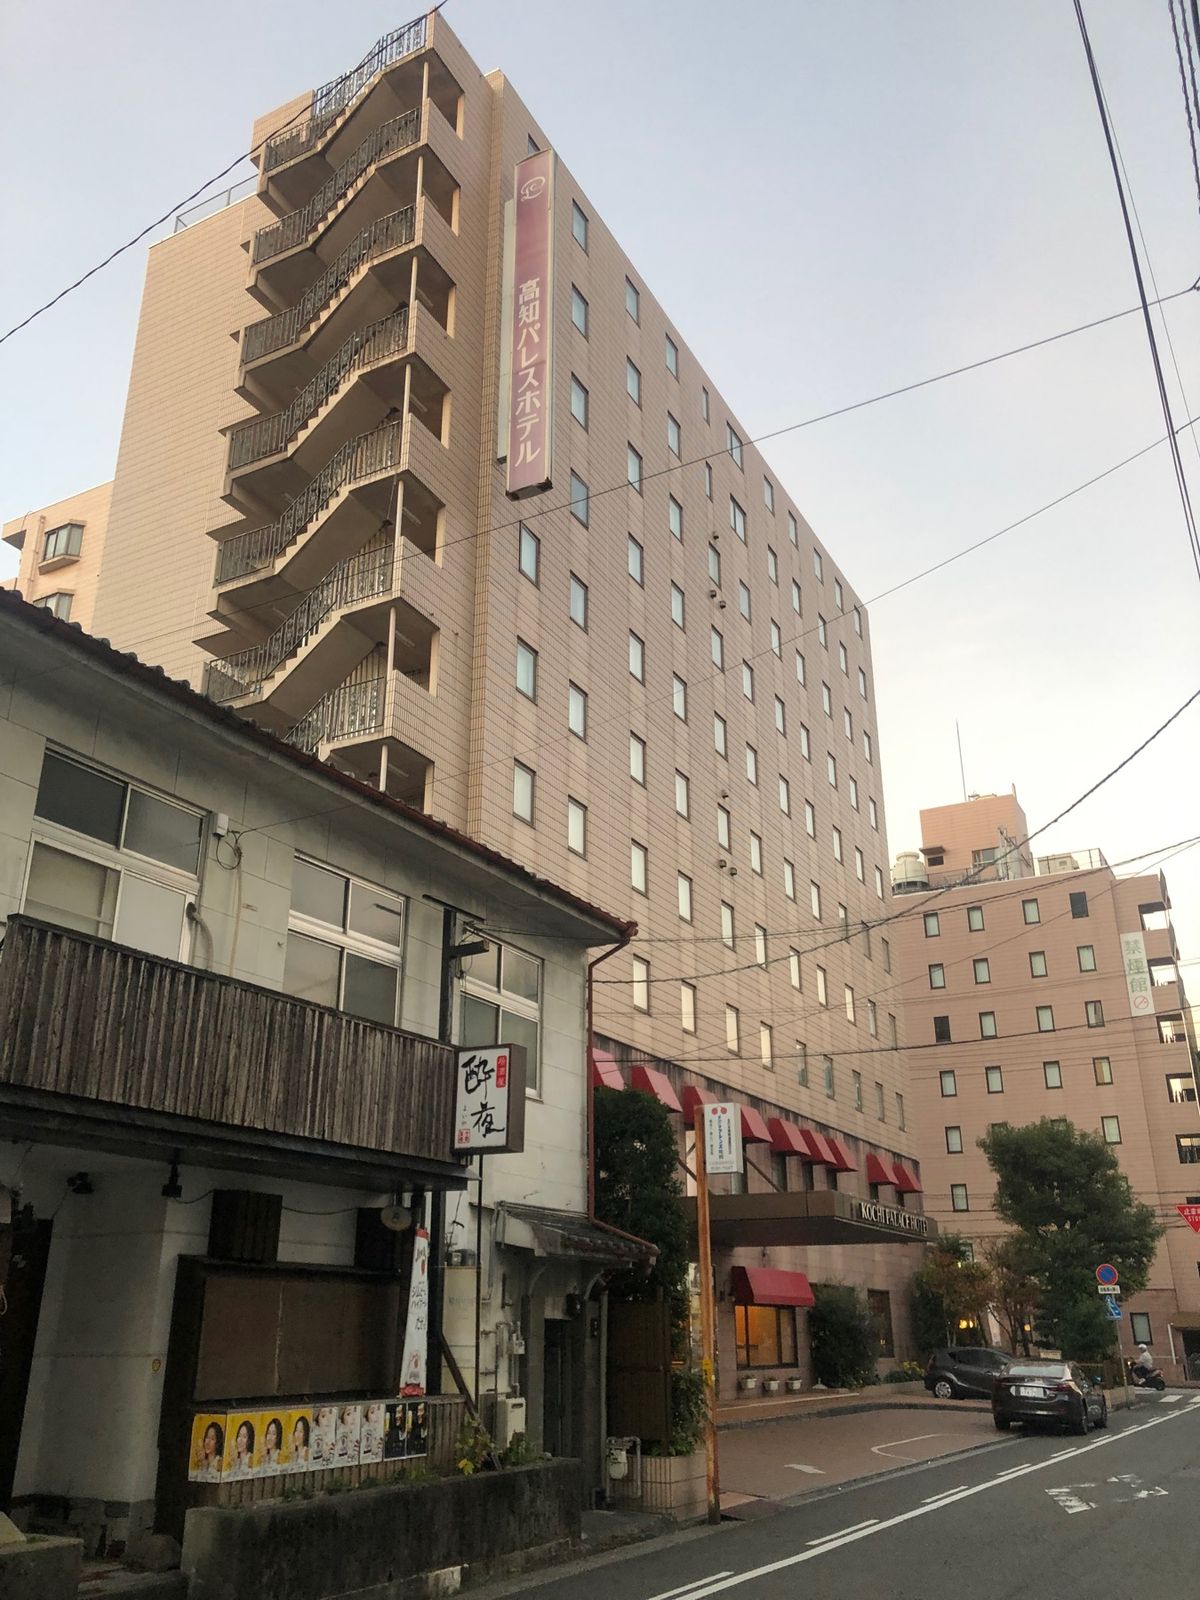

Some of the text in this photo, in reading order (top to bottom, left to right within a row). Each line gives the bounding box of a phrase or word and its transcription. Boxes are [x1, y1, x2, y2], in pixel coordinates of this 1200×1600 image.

[515, 278, 541, 468] 高知パレスホテル
[1125, 939, 1148, 993] 禁煙館
[861, 1202, 885, 1223] KOCHI
[886, 1208, 909, 1229] PALACE
